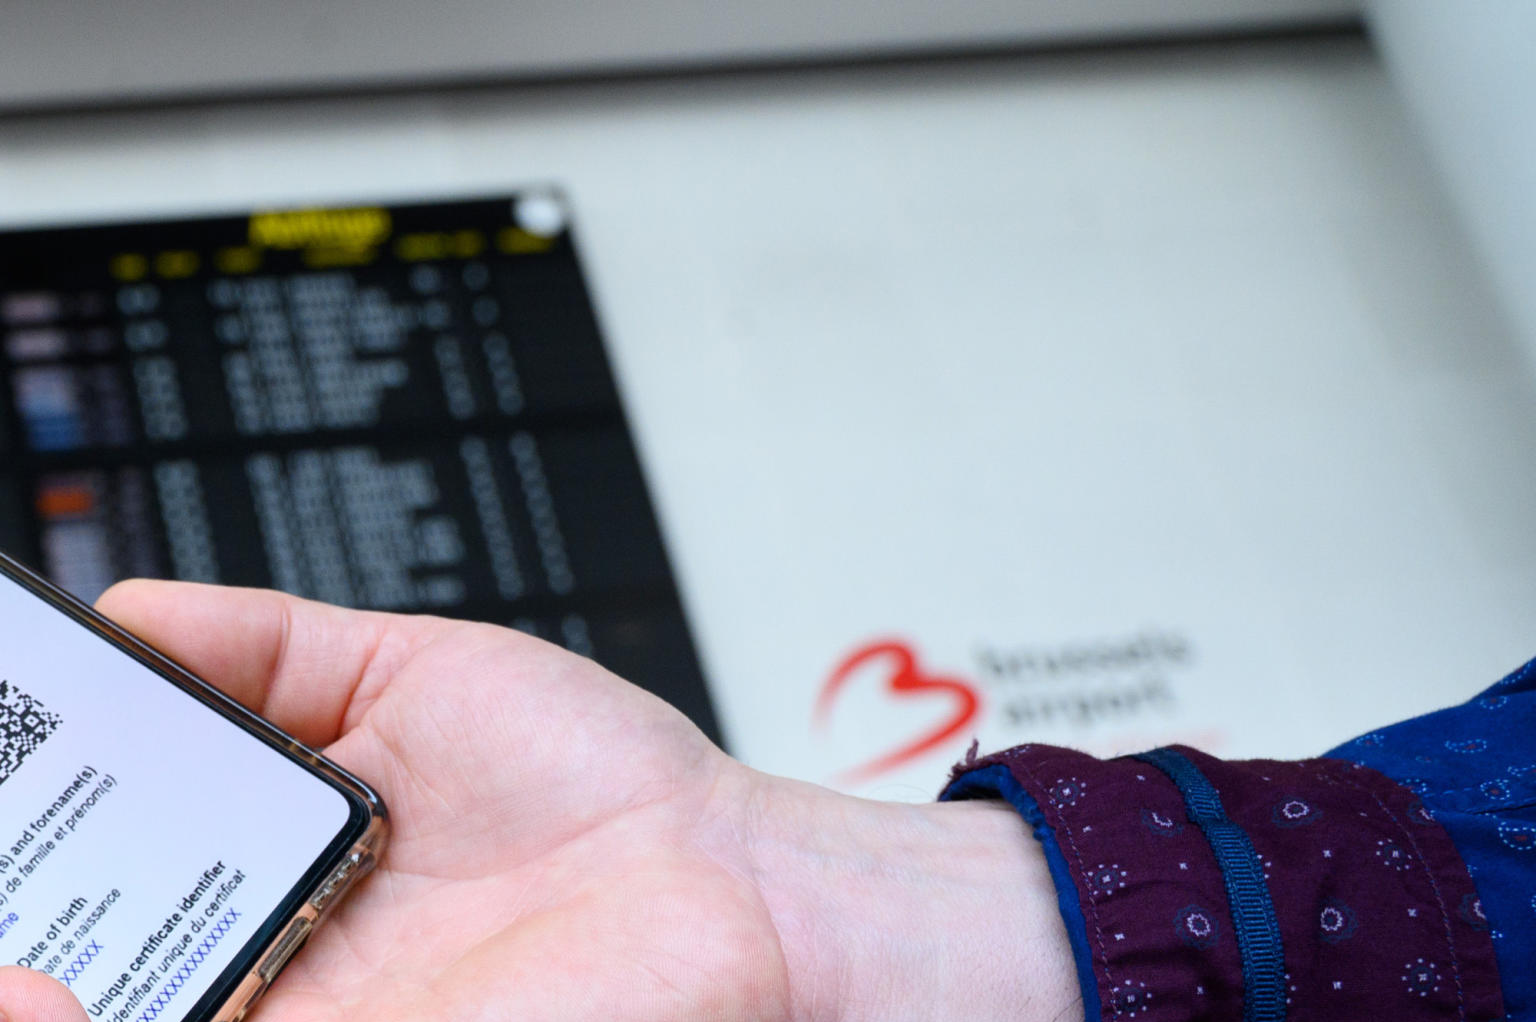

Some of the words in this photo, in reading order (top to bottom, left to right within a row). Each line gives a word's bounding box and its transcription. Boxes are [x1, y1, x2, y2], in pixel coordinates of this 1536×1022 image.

[5, 876, 22, 893] de
[19, 840, 56, 878] famille
[54, 826, 68, 841] et
[65, 774, 118, 832] prénom(s)
[10, 830, 35, 857] and
[29, 765, 98, 833] forename(s)
[16, 941, 48, 969] Date
[46, 923, 62, 941] of
[56, 897, 88, 926] birth
[37, 954, 62, 974] ate
[60, 940, 76, 955] de
[74, 889, 121, 940] naissance
[87, 972, 132, 1017] Unique
[129, 912, 183, 972] certificate
[176, 860, 226, 913] identifier
[158, 933, 193, 973] unique
[191, 916, 207, 933] du
[204, 868, 246, 918] certificat
